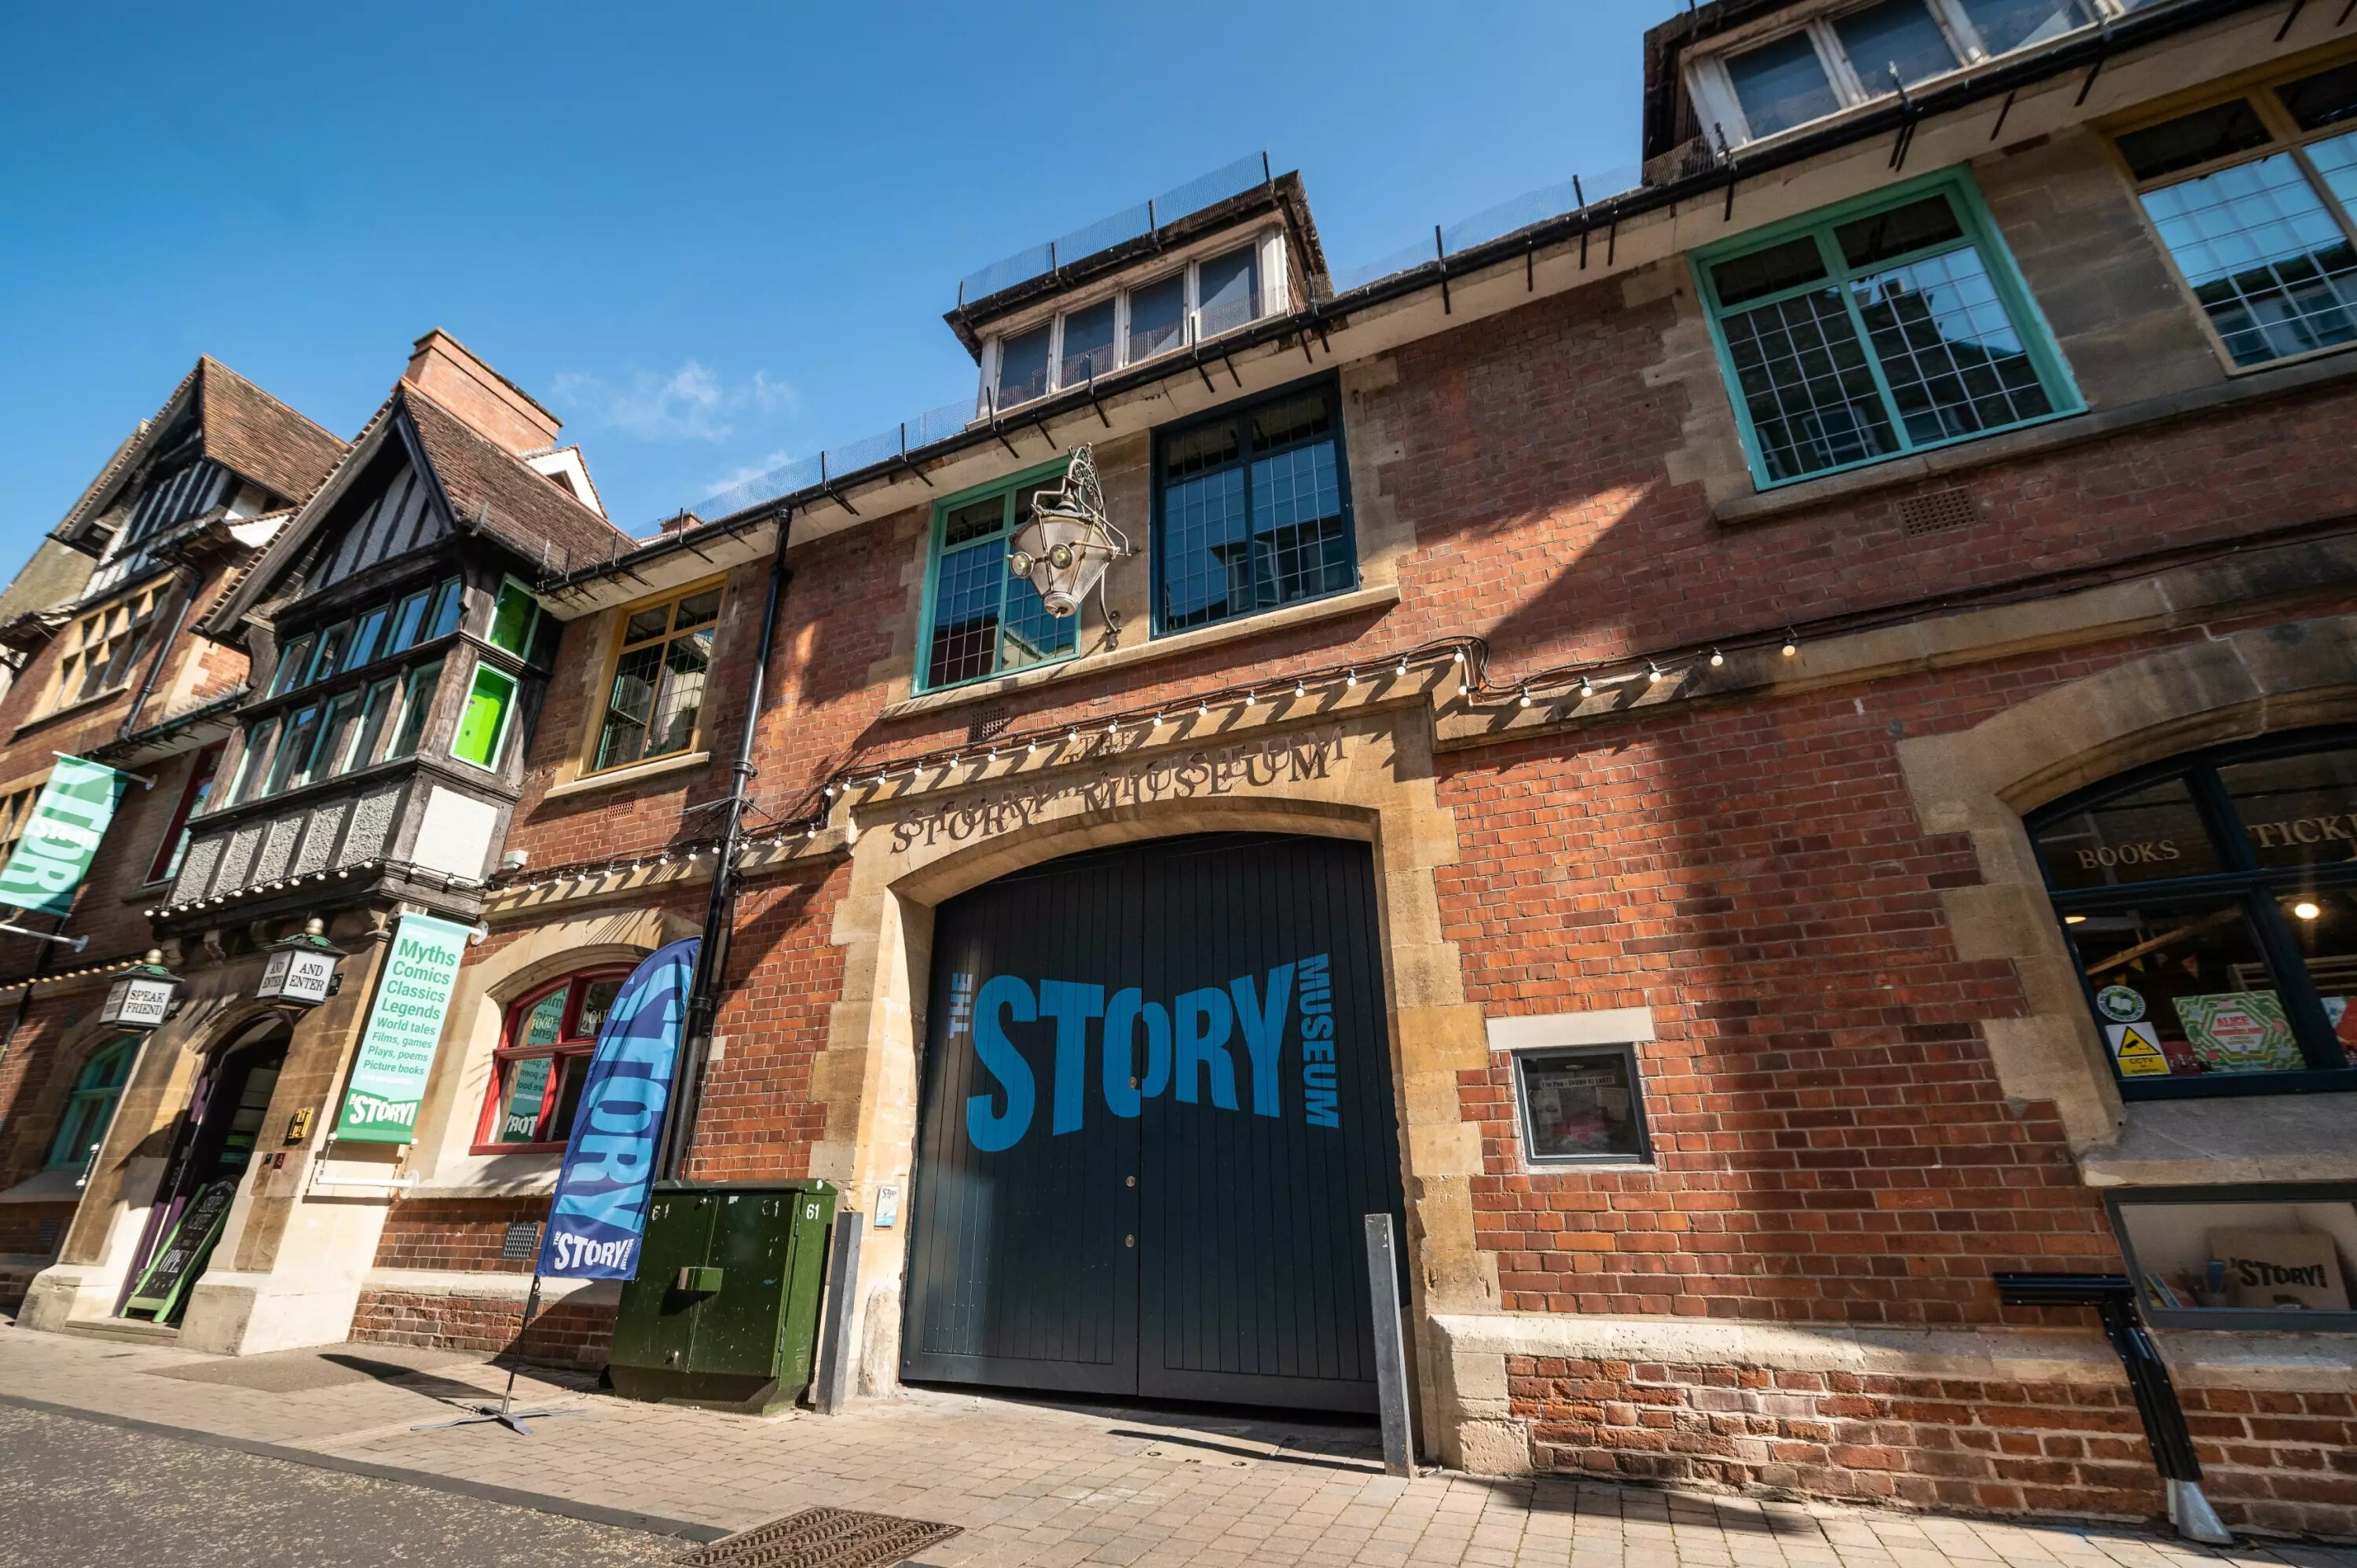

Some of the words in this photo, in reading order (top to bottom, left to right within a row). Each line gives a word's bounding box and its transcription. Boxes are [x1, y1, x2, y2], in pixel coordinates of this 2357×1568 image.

[1079, 731, 1134, 753] THE
[900, 782, 1053, 837] STORY
[1098, 724, 1349, 804] MUSEUM
[2074, 840, 2181, 870] BOOKS
[398, 938, 456, 967] Myths
[299, 963, 324, 976] AND
[392, 961, 451, 985] Comics
[288, 975, 325, 992] ENTER
[387, 980, 445, 1003] Classics
[130, 989, 165, 1004] SPEAK
[947, 972, 973, 1039] THE
[126, 1002, 163, 1016] FRIEND
[381, 998, 441, 1020] Legends
[377, 1017, 409, 1031] World
[410, 1023, 436, 1035] tales
[530, 1017, 554, 1030] FOOD
[372, 1031, 399, 1046] Films,
[401, 1038, 432, 1049] games
[1297, 952, 1340, 1129] MUSEUM
[367, 1046, 396, 1059] Plays,
[398, 1051, 428, 1062] poems
[966, 961, 1296, 1152] STORY
[363, 1060, 397, 1072] Picture
[398, 1064, 424, 1075] books
[806, 1203, 820, 1220] 61
[552, 1231, 562, 1247] THE
[554, 1233, 629, 1270] STORY
[2238, 1258, 2319, 1287] STORY
